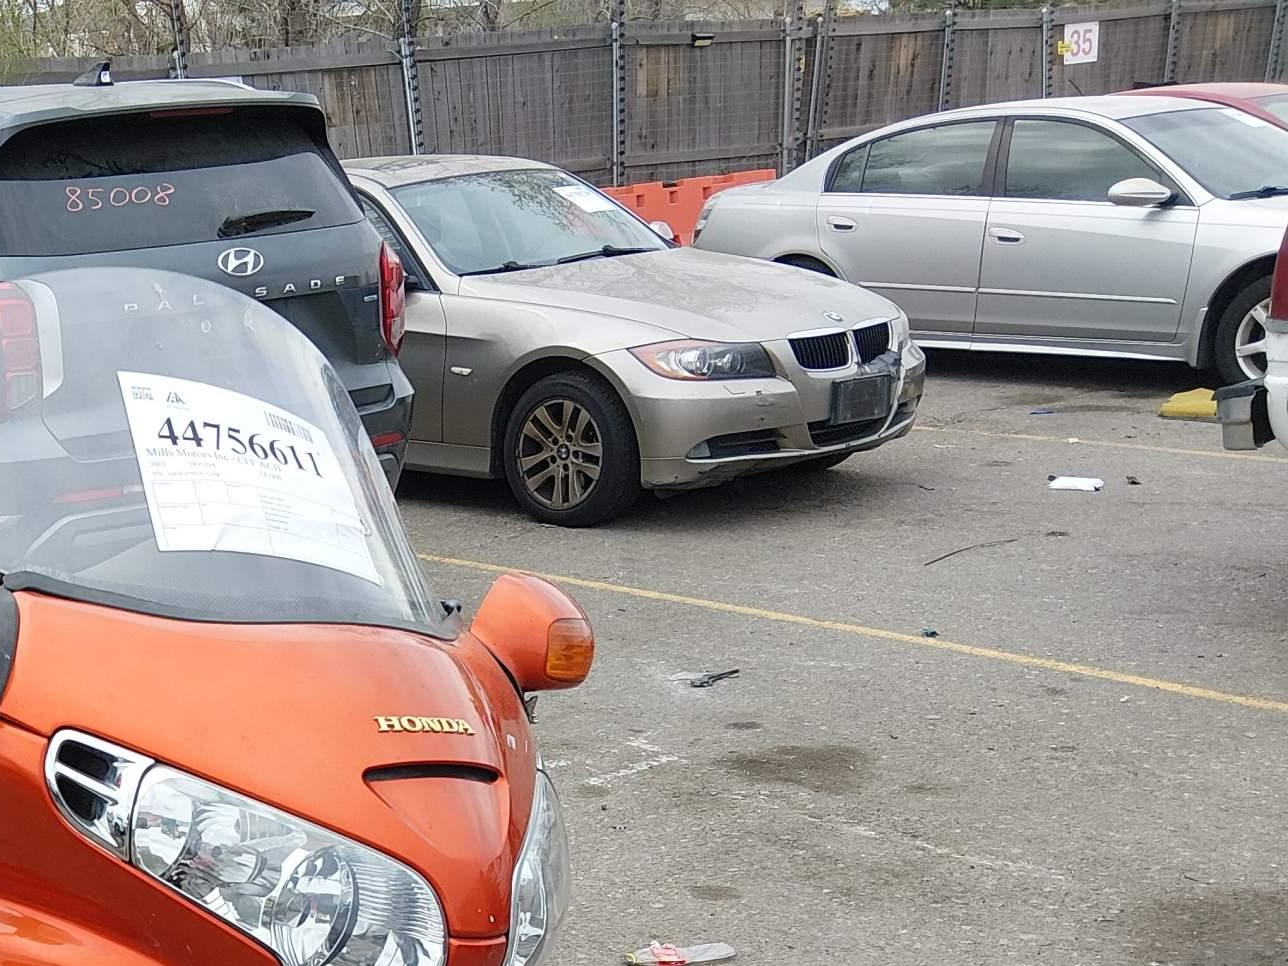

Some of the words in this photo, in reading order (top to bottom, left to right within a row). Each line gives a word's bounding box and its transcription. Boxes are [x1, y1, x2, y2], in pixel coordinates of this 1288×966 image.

[1070, 28, 1093, 58] 35
[65, 183, 175, 212] 85008
[124, 276, 345, 312] PALSADE
[157, 416, 324, 478] 44756611
[372, 715, 477, 736] HONDA
